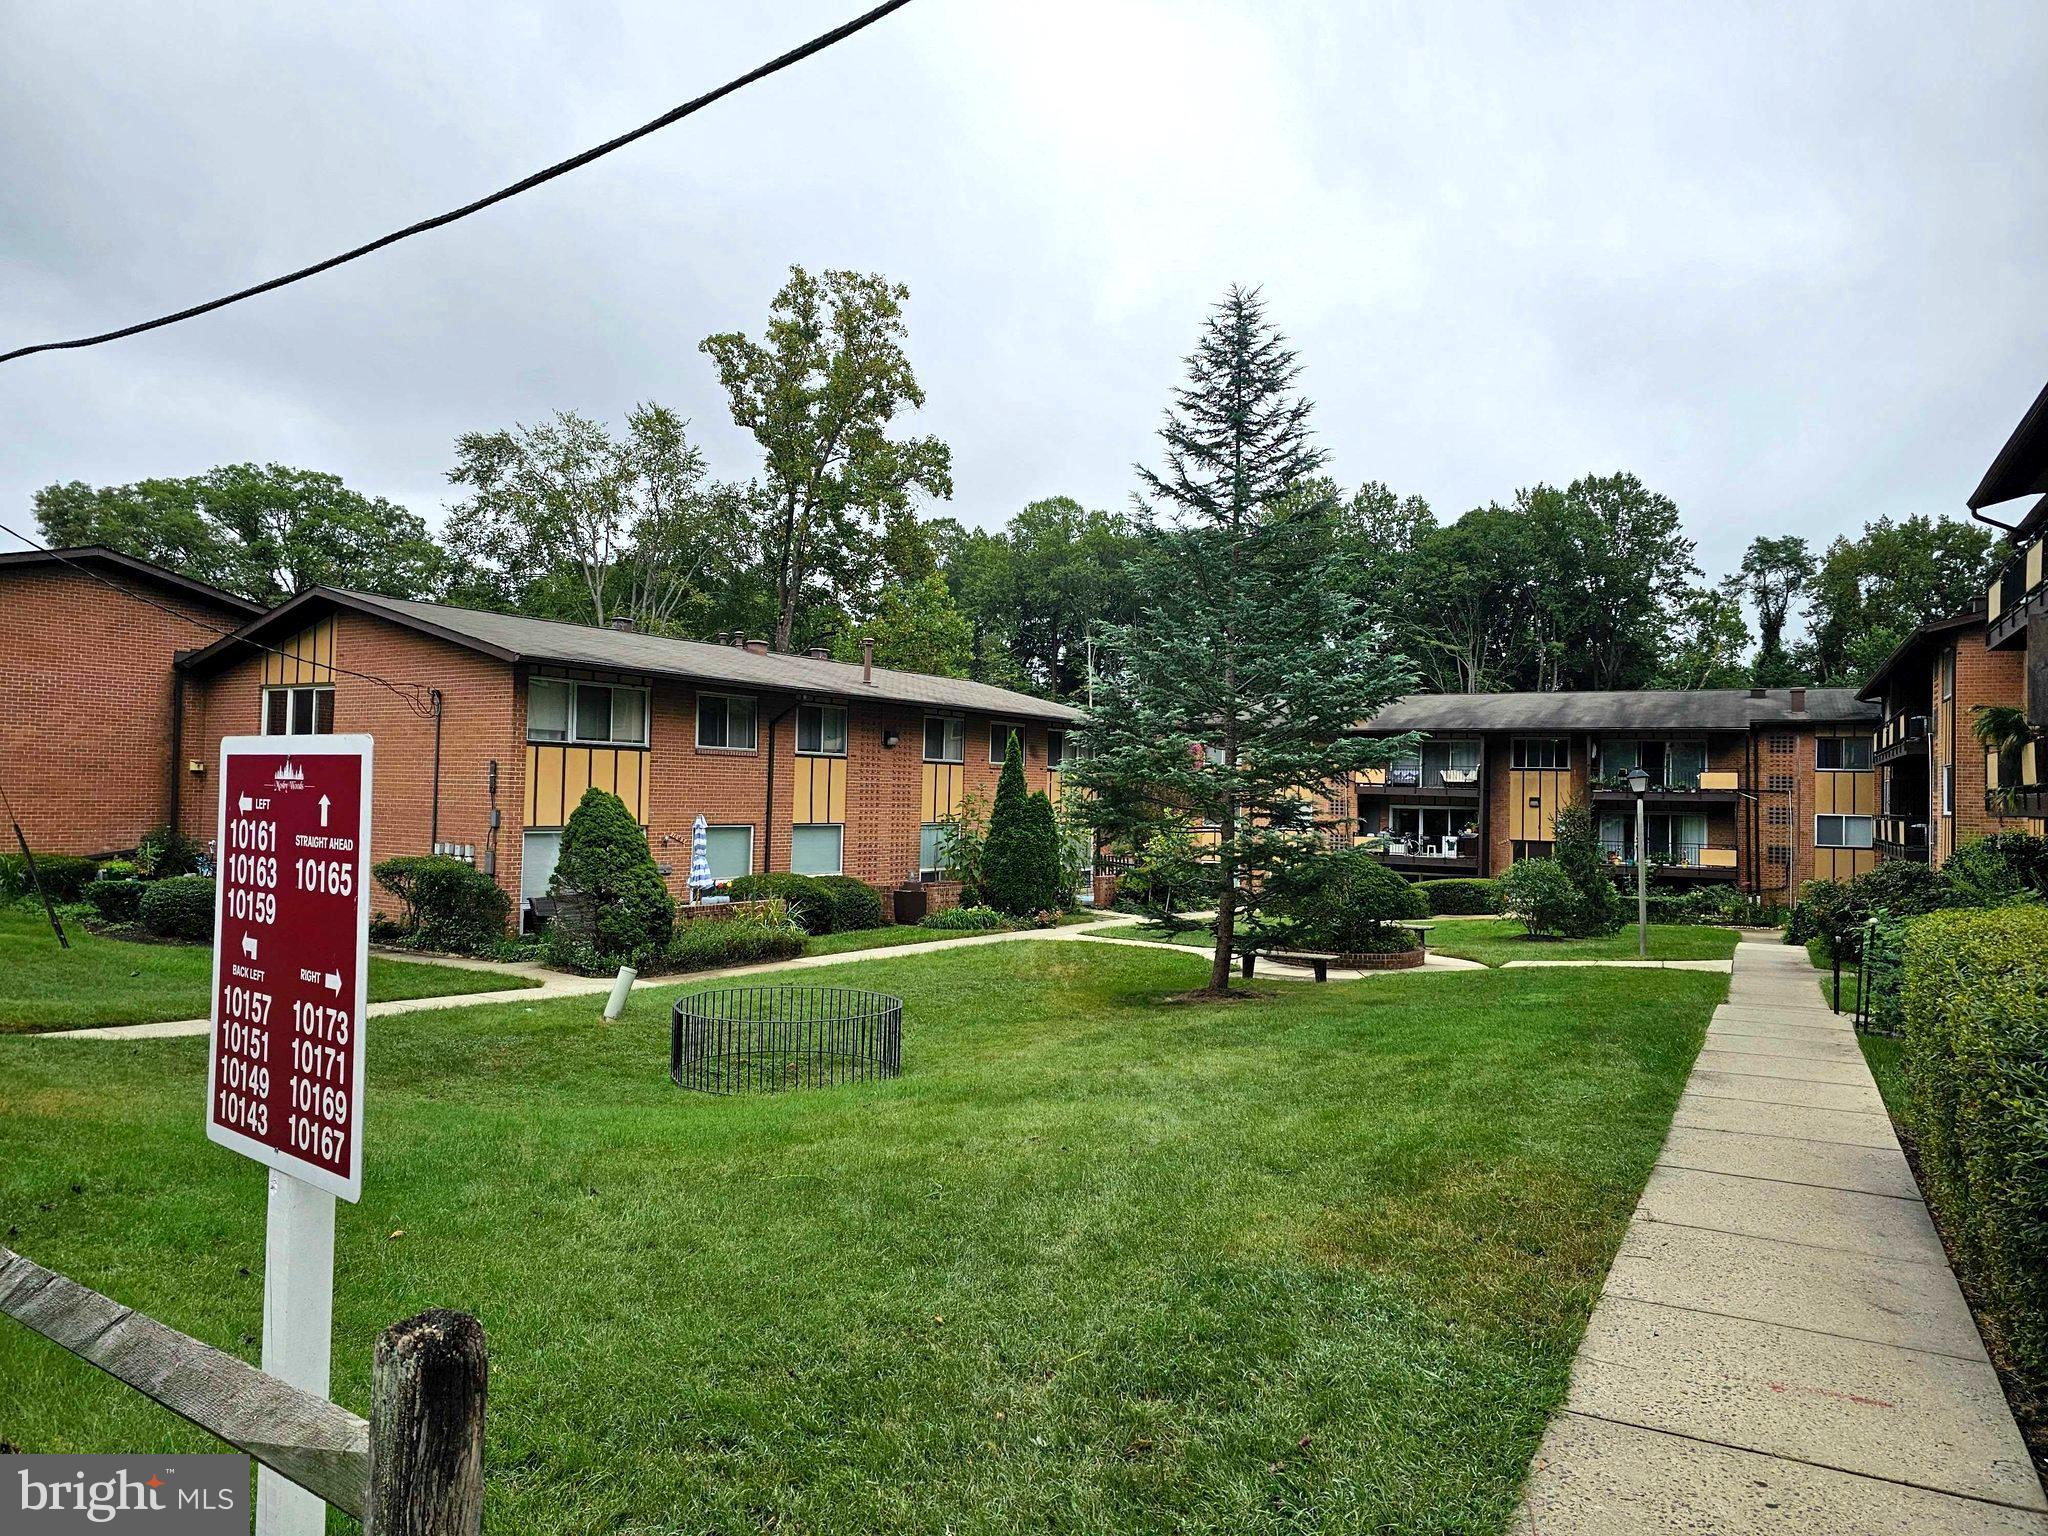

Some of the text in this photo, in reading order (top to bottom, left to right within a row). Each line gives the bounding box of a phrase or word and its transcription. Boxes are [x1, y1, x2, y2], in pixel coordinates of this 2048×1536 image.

[255, 798, 271, 810] LEFT
[230, 818, 276, 852] 10161
[295, 834, 354, 851] STRAIGHT AHEAD
[228, 853, 277, 889] 10163
[295, 858, 353, 897] 10165
[227, 887, 276, 925] 10159
[232, 964, 265, 983] BACK LEFT
[300, 968, 321, 984] RIGHT
[224, 984, 272, 1026] 10157
[293, 999, 349, 1046] 10173
[222, 1019, 269, 1063] 10151
[291, 1037, 345, 1085] 10171
[221, 1054, 270, 1099] 10149
[219, 1089, 268, 1136] 10143
[289, 1075, 347, 1125] 10169
[288, 1113, 345, 1164] 10167
